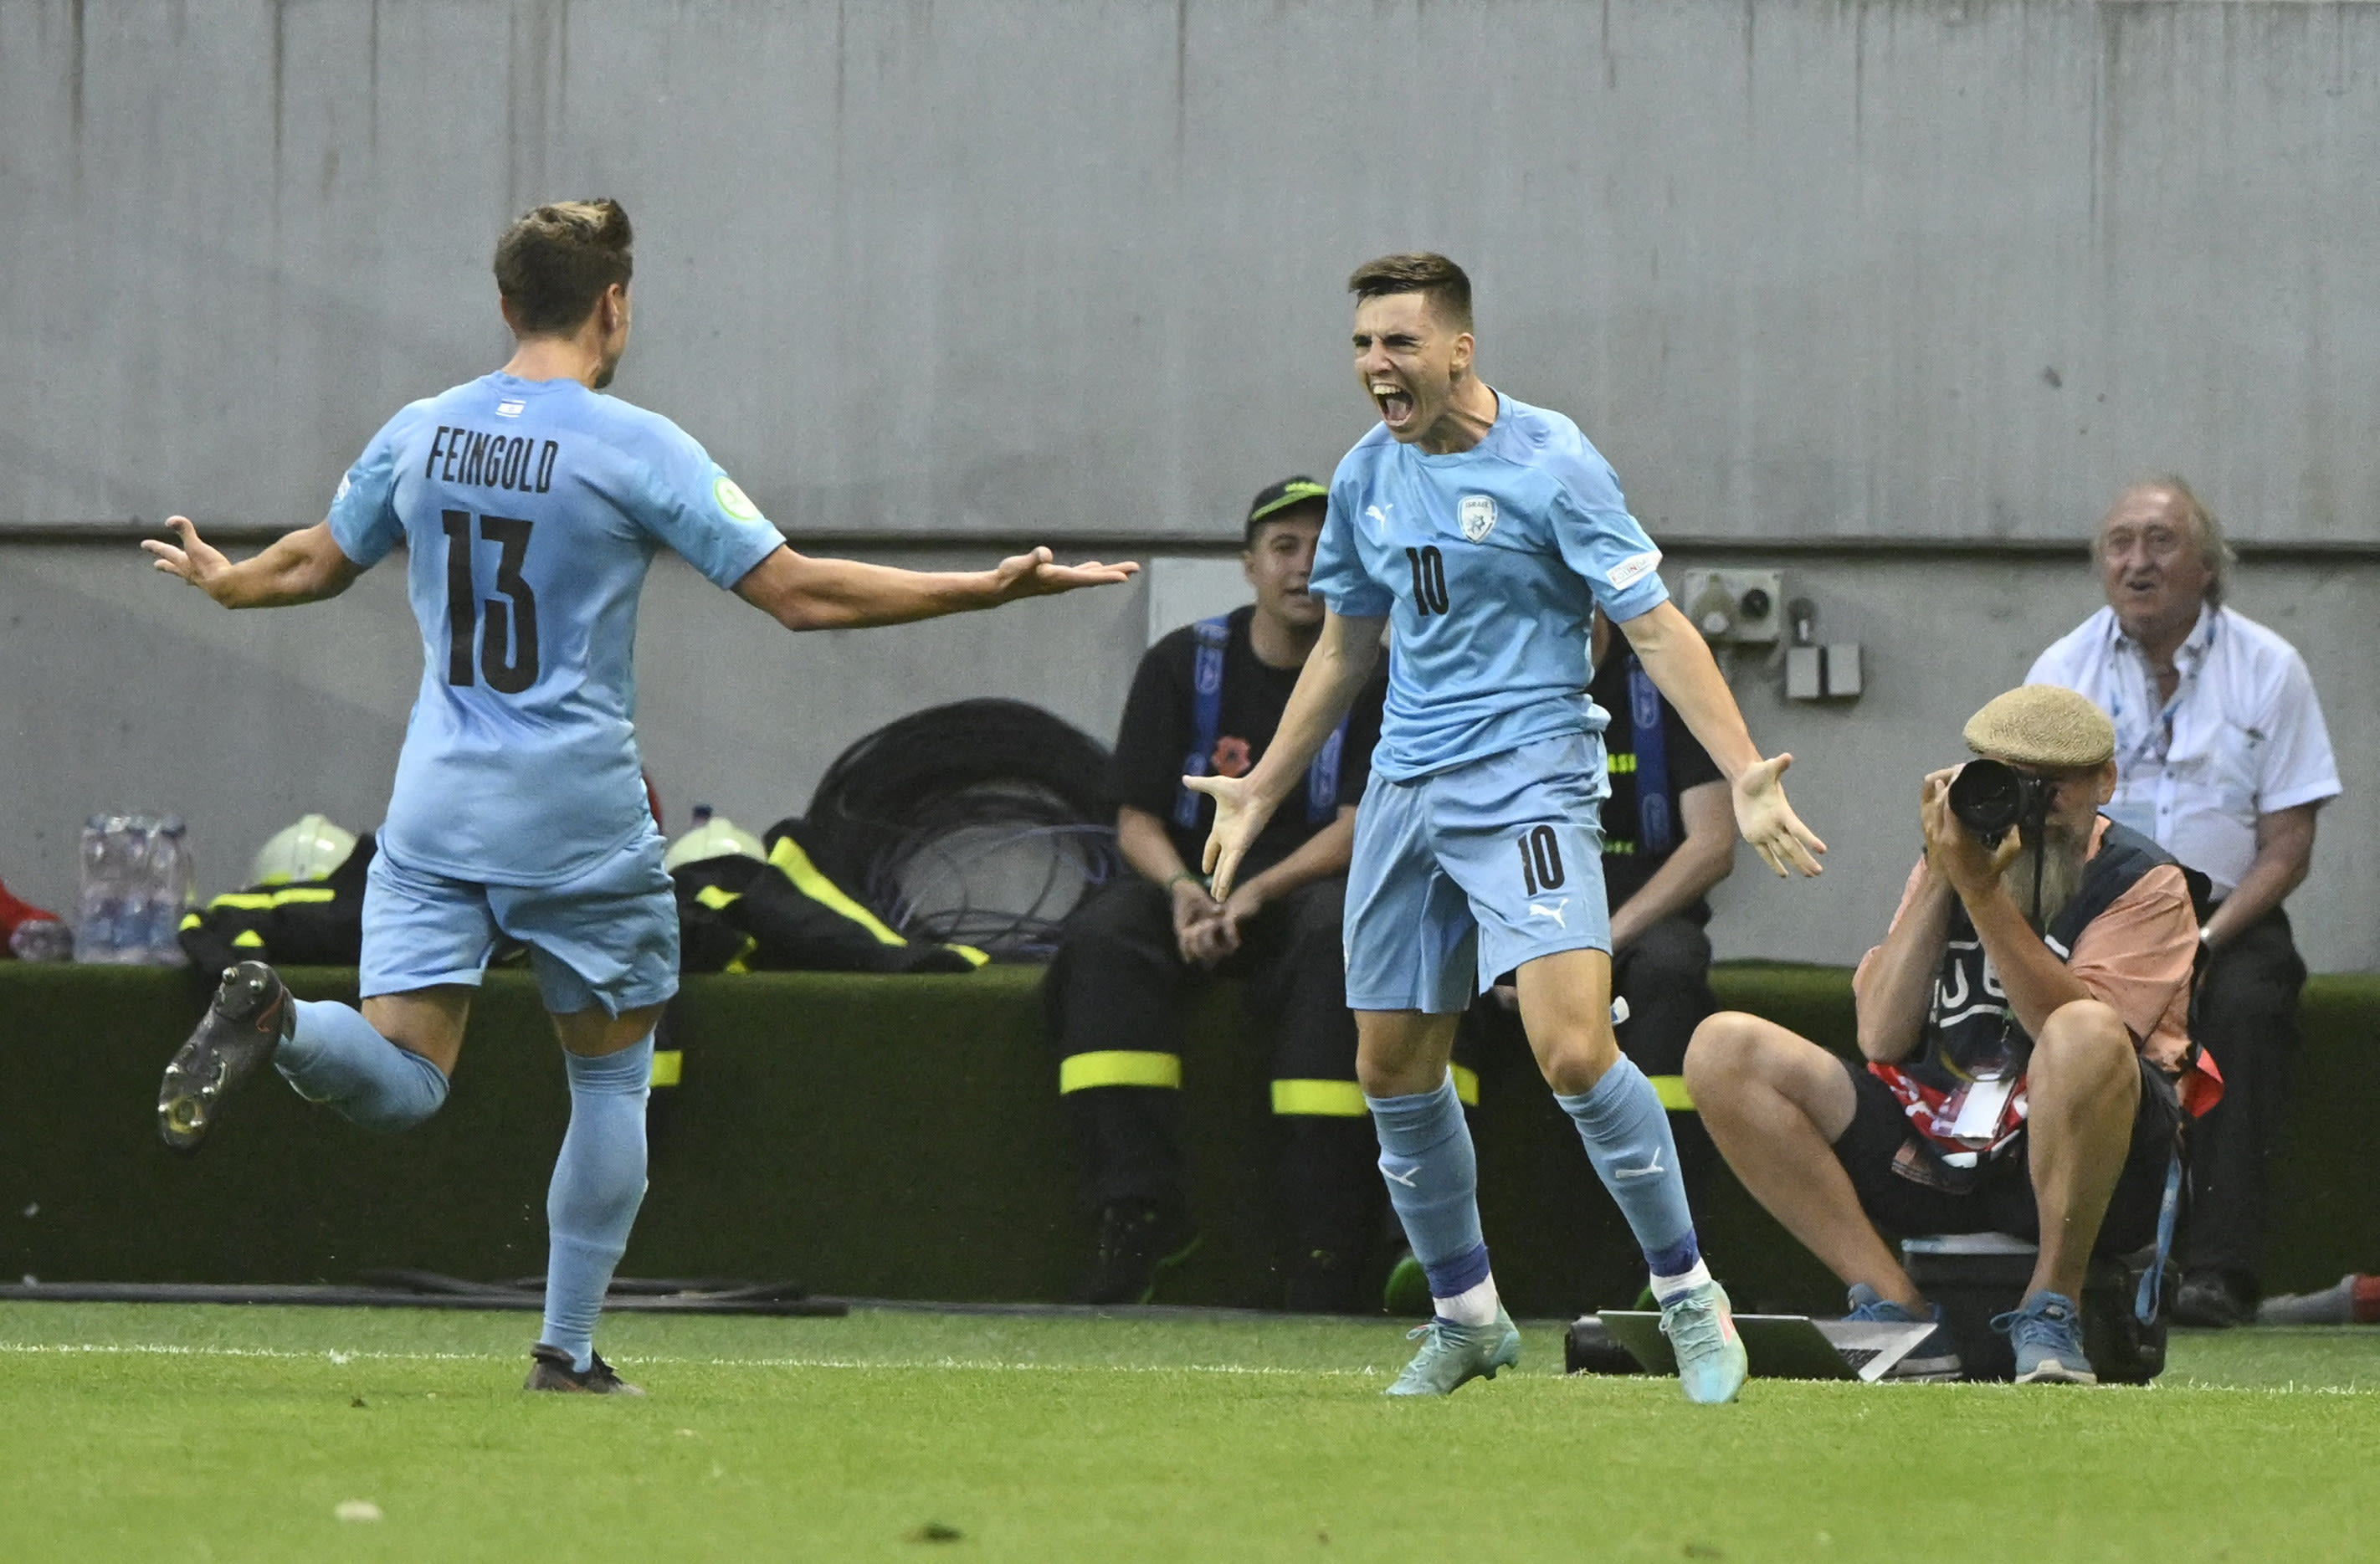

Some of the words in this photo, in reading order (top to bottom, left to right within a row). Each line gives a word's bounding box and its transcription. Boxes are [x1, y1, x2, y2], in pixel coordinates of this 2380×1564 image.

[426, 426, 558, 493] FEINGOLD
[442, 510, 540, 694] 13
[1406, 546, 1449, 616] 10
[1517, 825, 1565, 896] 10
